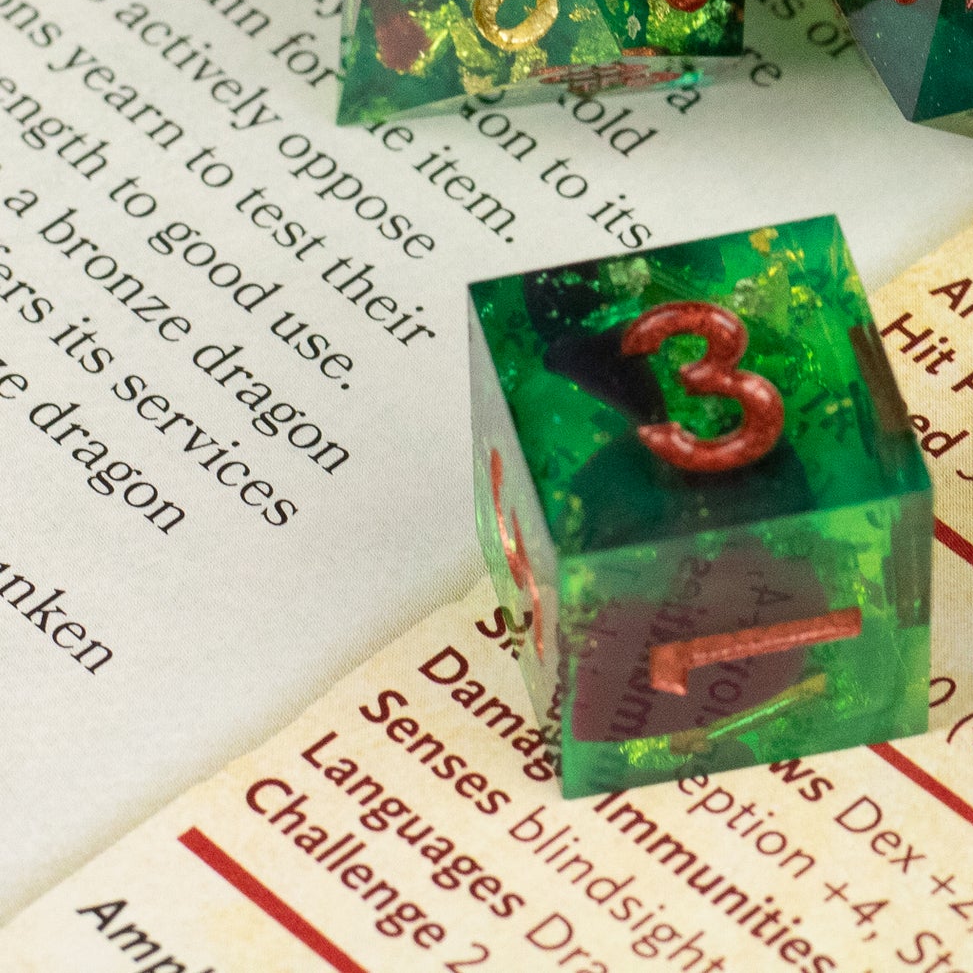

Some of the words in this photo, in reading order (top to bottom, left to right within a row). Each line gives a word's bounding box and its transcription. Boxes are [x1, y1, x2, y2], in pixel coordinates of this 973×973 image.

[46, 45, 185, 151] yearn
[184, 146, 235, 189] to
[234, 187, 326, 262] test
[320, 257, 436, 347] their
[113, 2, 281, 131] actively
[277, 133, 437, 260] oppose
[413, 145, 517, 244] item.
[269, 31, 348, 88] for
[462, 102, 537, 163] ion
[541, 156, 589, 201] to
[588, 193, 653, 250] its
[572, 98, 658, 157] old
[2, 188, 40, 219] a
[37, 207, 192, 343] bronze
[191, 344, 351, 476] dragon
[108, 177, 158, 219] to
[146, 221, 284, 314] good
[269, 311, 355, 391] use.
[881, 313, 955, 375] Hit
[0, 244, 55, 325] ers
[49, 316, 115, 375] its
[110, 374, 299, 527] services
[0, 358, 29, 400] e
[28, 401, 186, 536] dragon
[620, 299, 785, 474] 3
[910, 413, 970, 459] ed
[300, 730, 526, 919] Languages
[358, 689, 511, 816] Senses
[416, 643, 562, 784] Damag
[594, 779, 837, 973] Immunities
[771, 759, 834, 803] ws
[833, 795, 926, 874] Dex
[245, 777, 447, 951] Challenge
[443, 942, 491, 973] 2
[677, 767, 817, 879] eption
[824, 882, 891, 943] +4,
